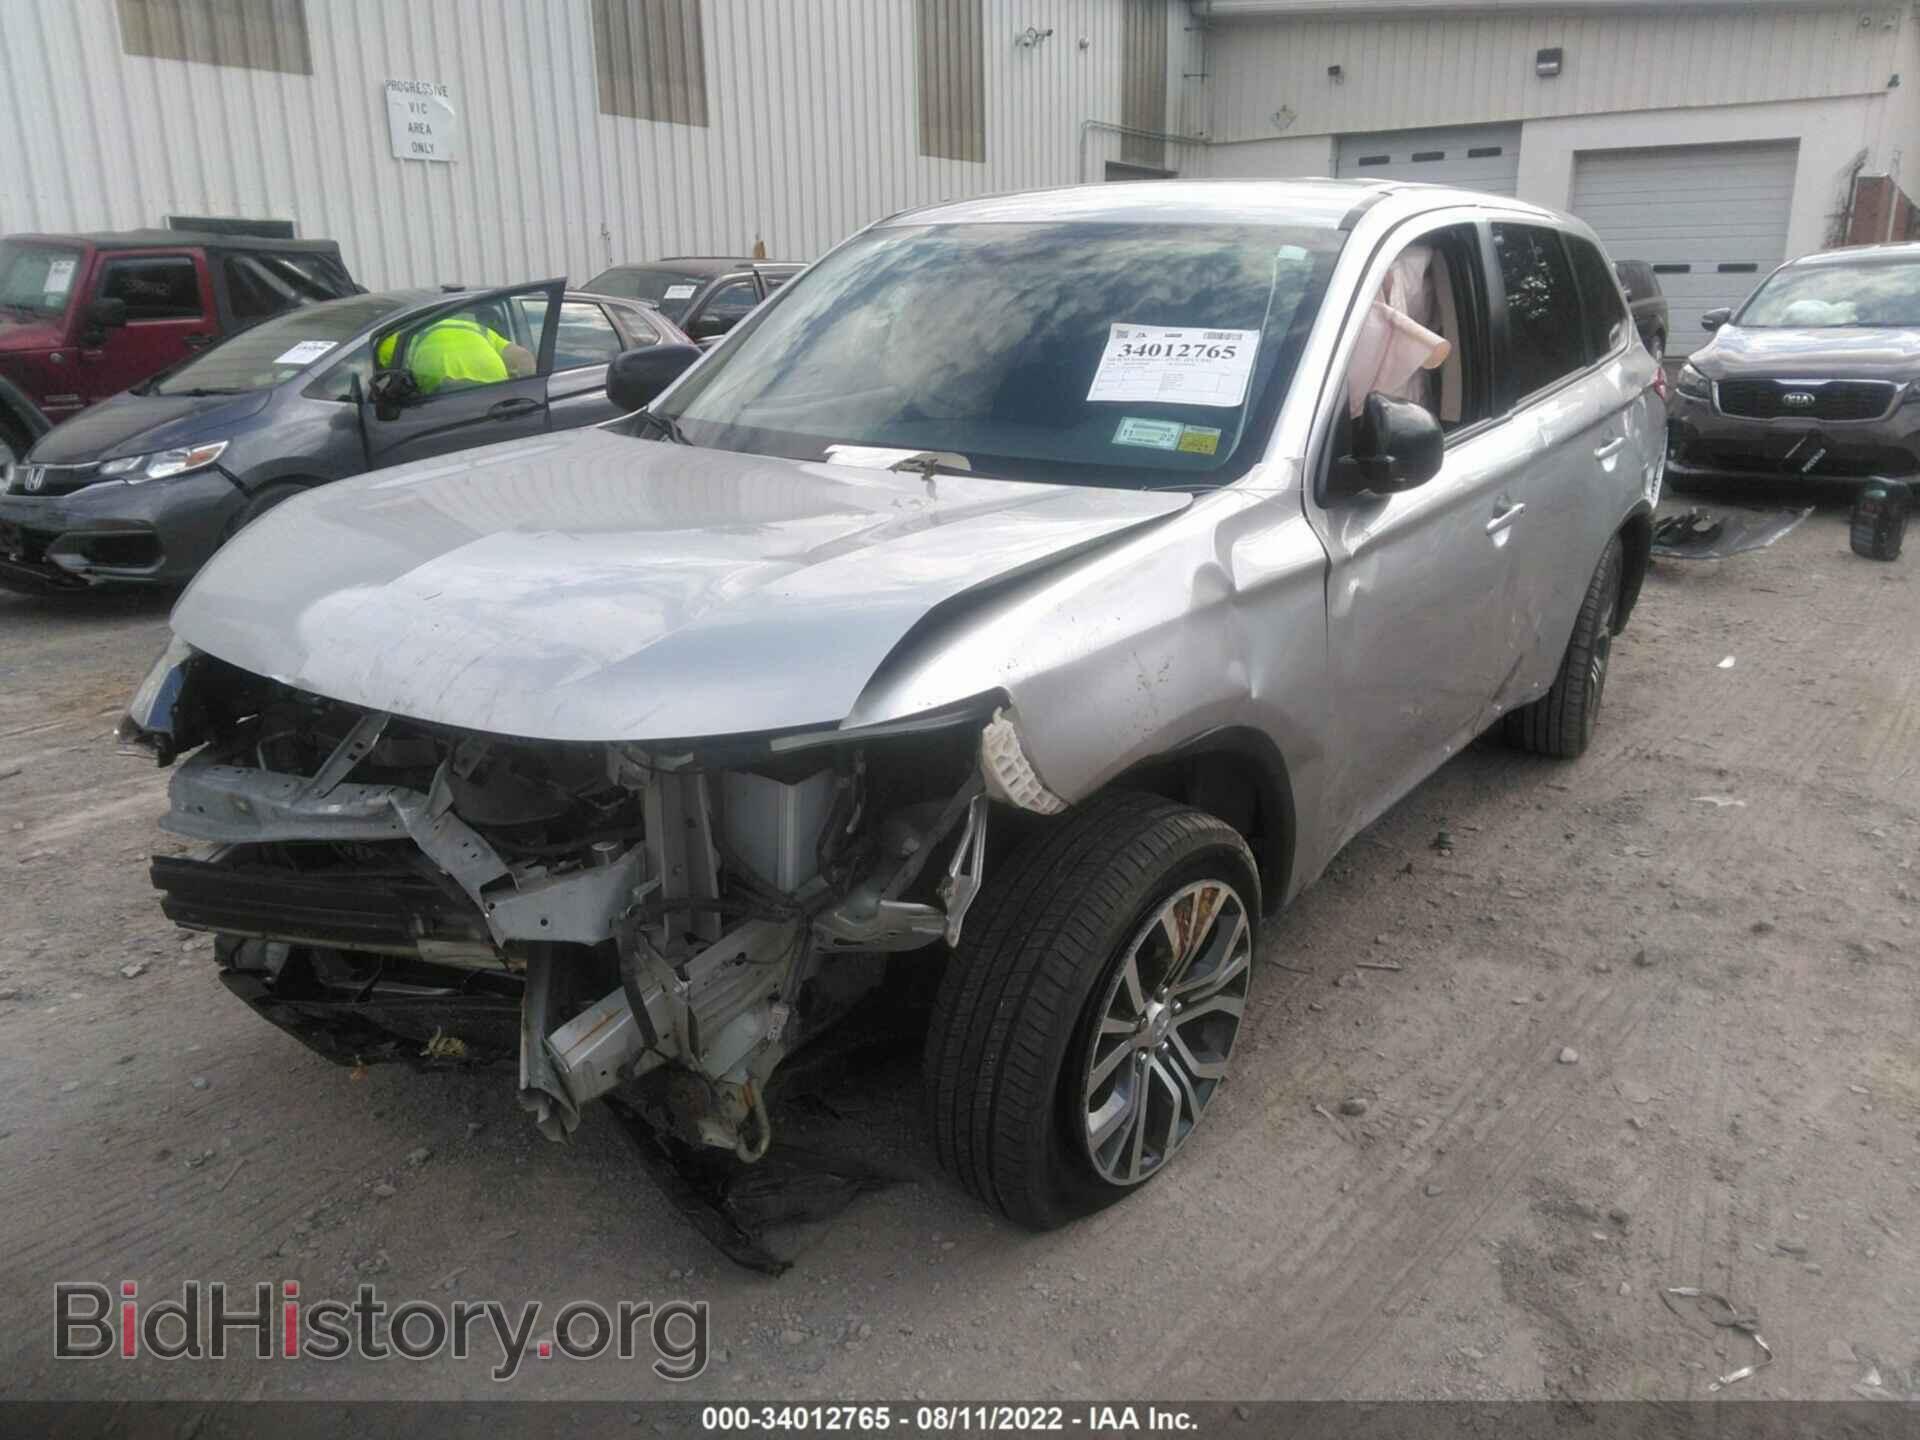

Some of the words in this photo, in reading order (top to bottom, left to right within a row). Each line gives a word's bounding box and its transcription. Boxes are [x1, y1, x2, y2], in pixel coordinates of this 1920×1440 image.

[384, 80, 449, 98] PROGRESSIVE
[407, 102, 428, 115] VIC
[408, 122, 432, 136] AREA
[411, 141, 434, 154] ONLY
[1116, 343, 1238, 360] 34012765
[1786, 394, 1811, 408] KIA
